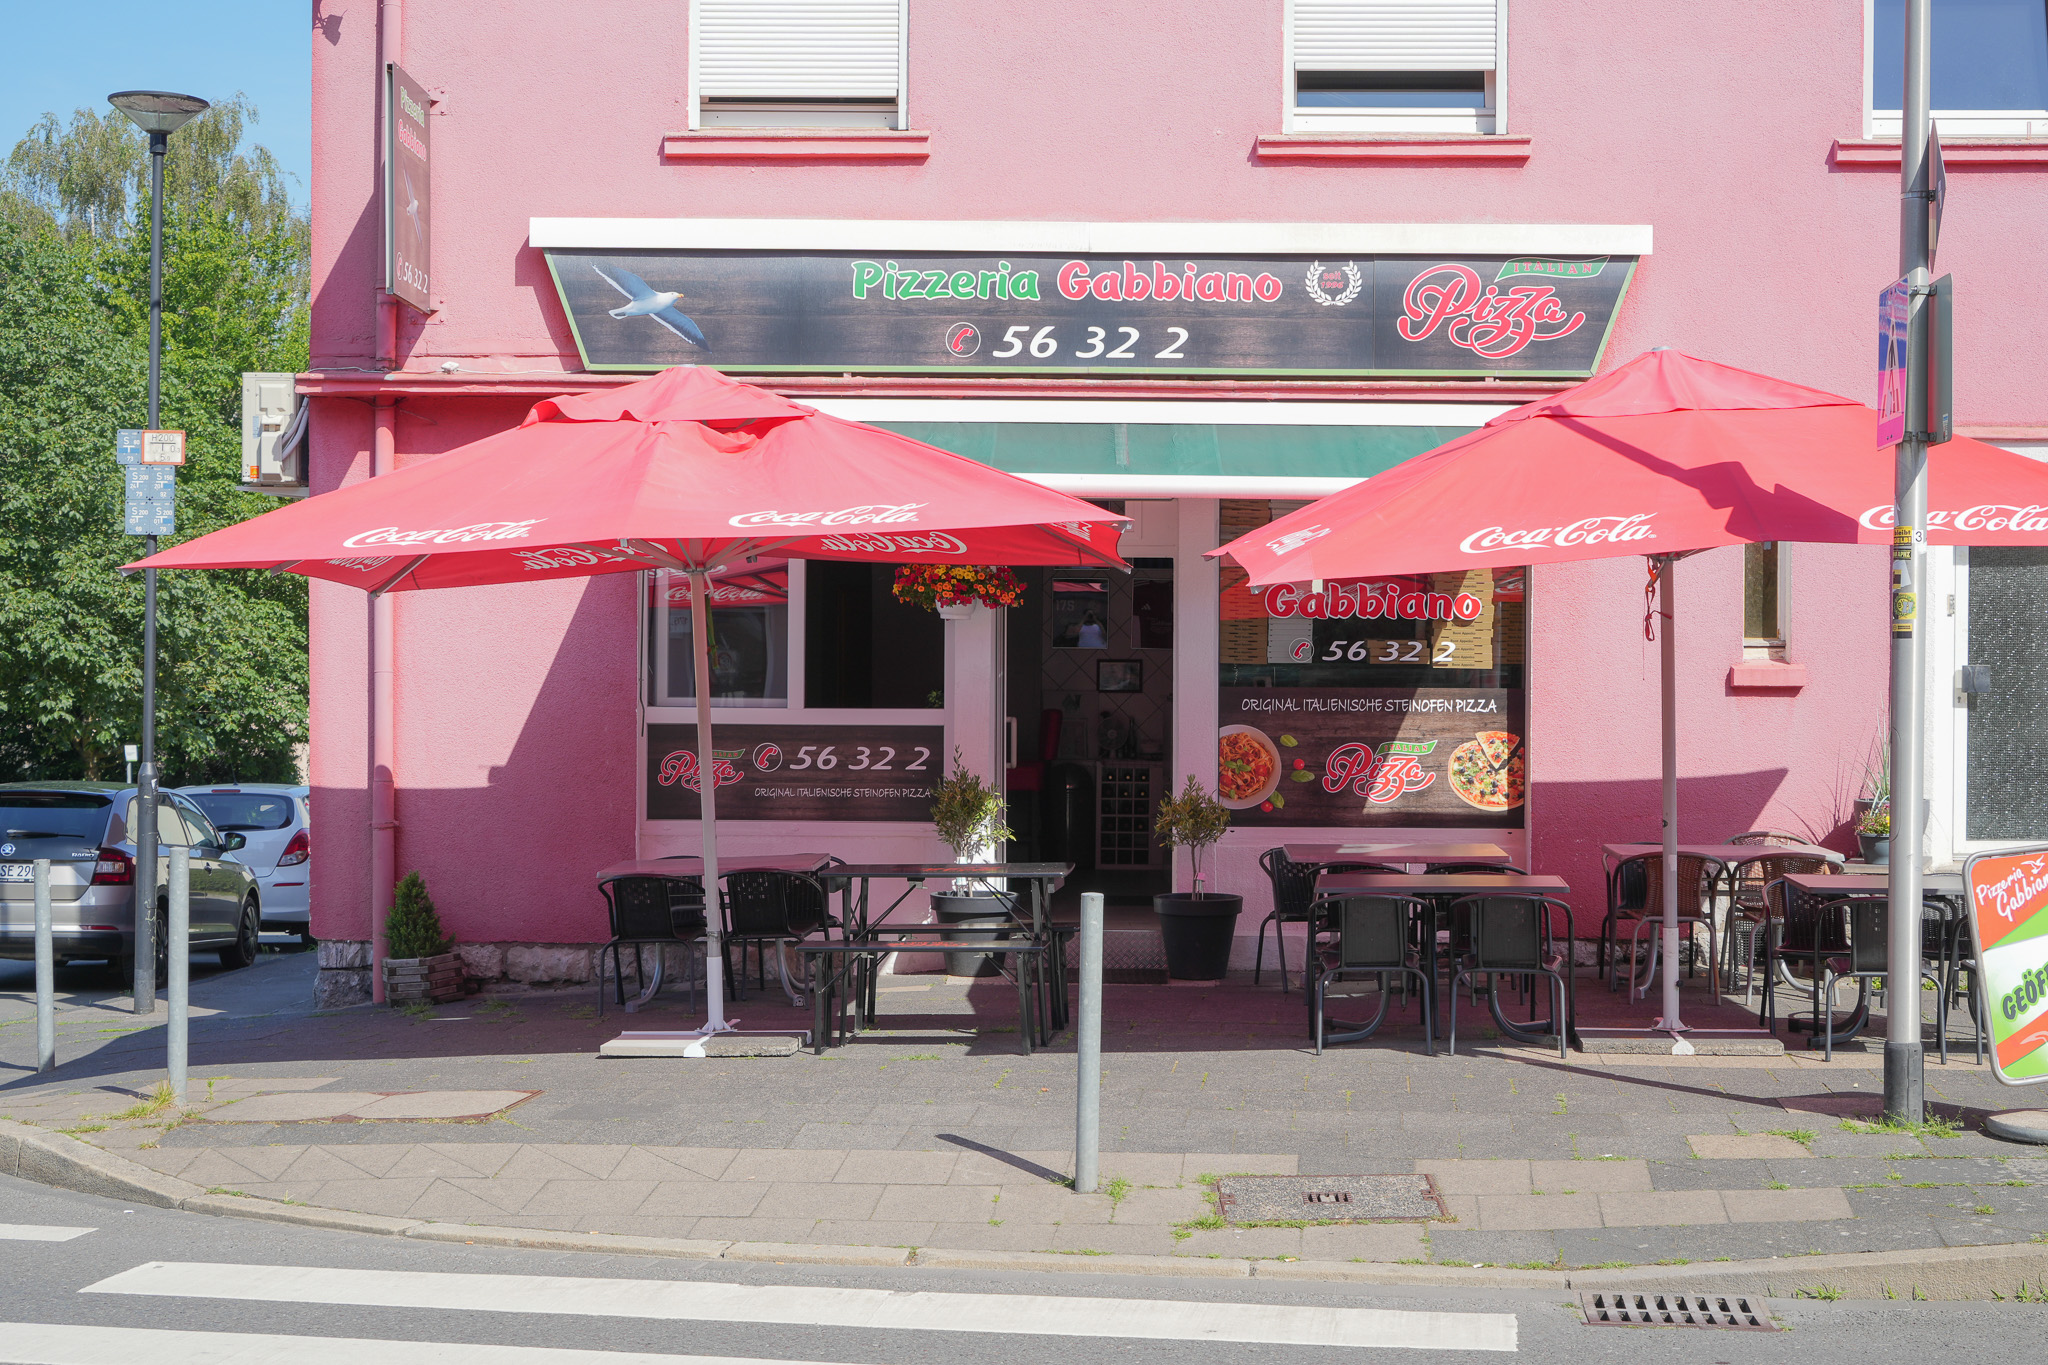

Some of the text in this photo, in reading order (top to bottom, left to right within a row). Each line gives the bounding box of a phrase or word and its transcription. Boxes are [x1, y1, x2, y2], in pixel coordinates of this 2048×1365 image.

[400, 85, 425, 128] Pizzeria
[398, 119, 427, 161] Gabbiano
[403, 262, 428, 294] 56 32 2
[851, 260, 1283, 302] Pizzeria Gabbiano
[1323, 271, 1341, 280] seit
[1514, 261, 1592, 274] ITALIAN
[1397, 263, 1586, 359] Pizza
[992, 325, 1189, 358] 56 32 2
[728, 502, 929, 527] Coca-Cola
[342, 518, 549, 548] Coca-Cola
[1459, 512, 1658, 554] Coca-Cola
[1915, 531, 1922, 542] 3
[1265, 582, 1482, 620] Gabbiano
[1322, 640, 1456, 662] 56 32 2
[1241, 698, 1497, 714] ORIGINAL ITALIENISCHE STEINOFEN PIZZA
[789, 746, 931, 770] 56 32 2
[1384, 744, 1428, 752] ITALIAN
[1322, 742, 1436, 803] Pizza
[754, 787, 931, 798] ORIGINAL ITALIENISCHE STEINOFEN PIZZA
[1976, 867, 2025, 906] Pizzeria
